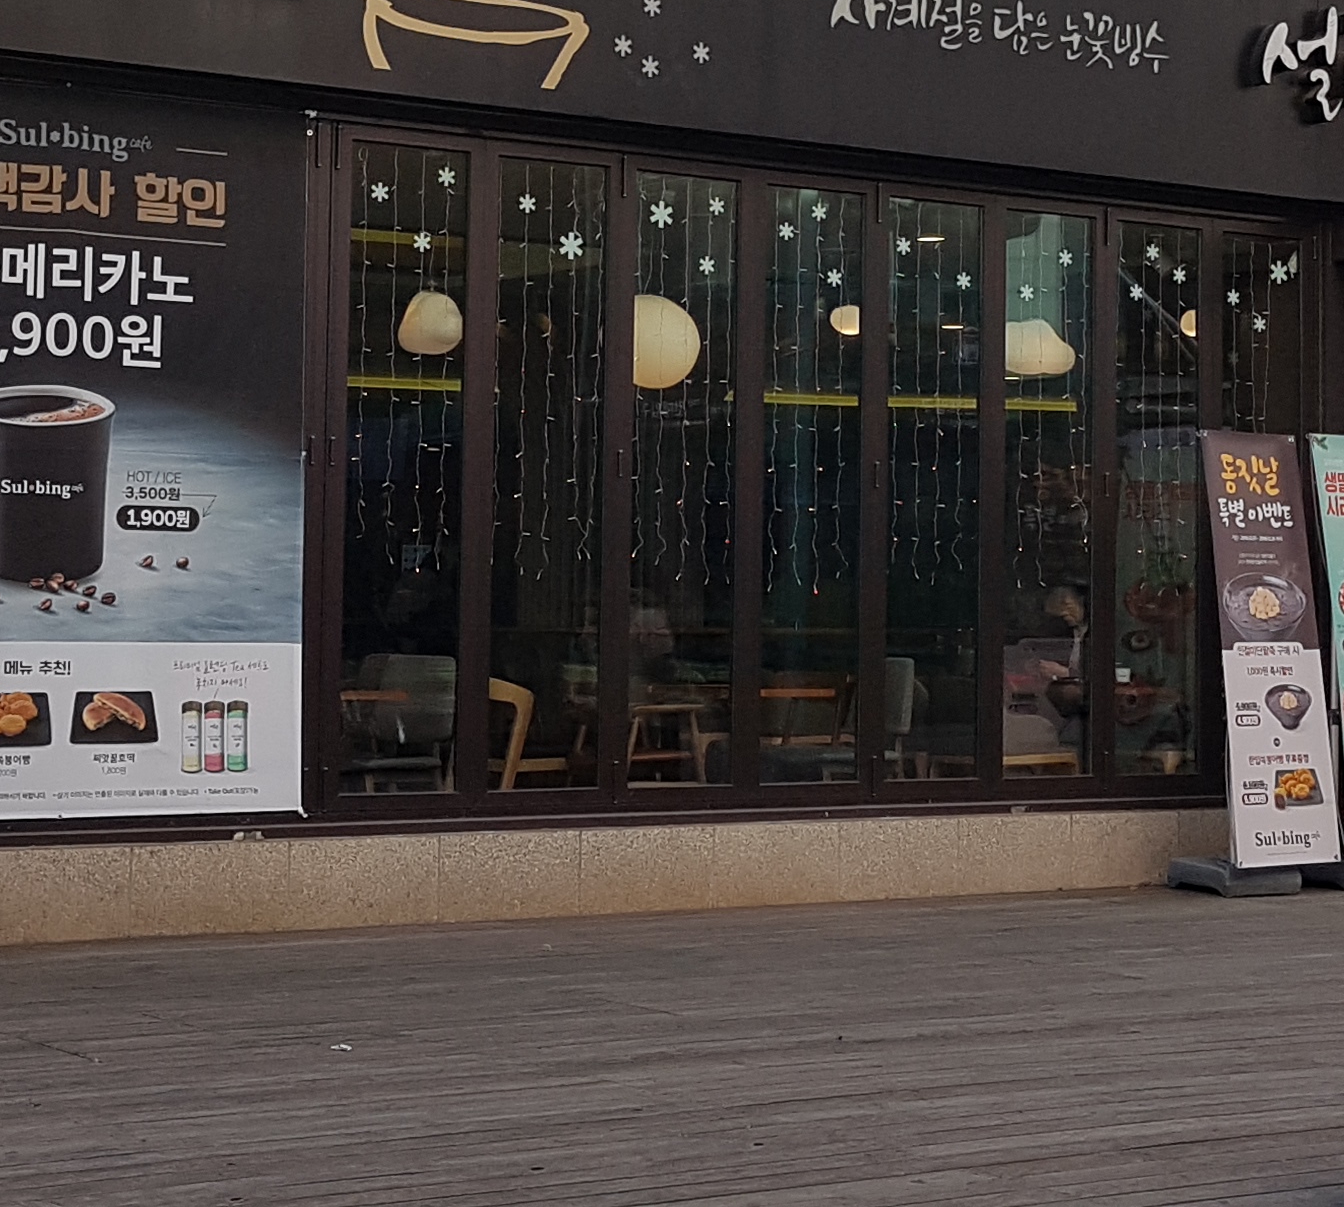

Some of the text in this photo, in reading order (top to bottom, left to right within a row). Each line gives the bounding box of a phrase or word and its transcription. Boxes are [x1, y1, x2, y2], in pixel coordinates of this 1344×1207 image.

[134, 172, 227, 229] 할인
[127, 470, 152, 484] HOT
[162, 472, 181, 484] ICE
[1221, 454, 1280, 496] 동짓날
[125, 486, 181, 501] 3,500원
[126, 508, 190, 529] 1,900원
[1218, 498, 1293, 528] 특별 이벤트
[4, 661, 33, 675] 메뉴
[39, 660, 71, 676] 추천!
